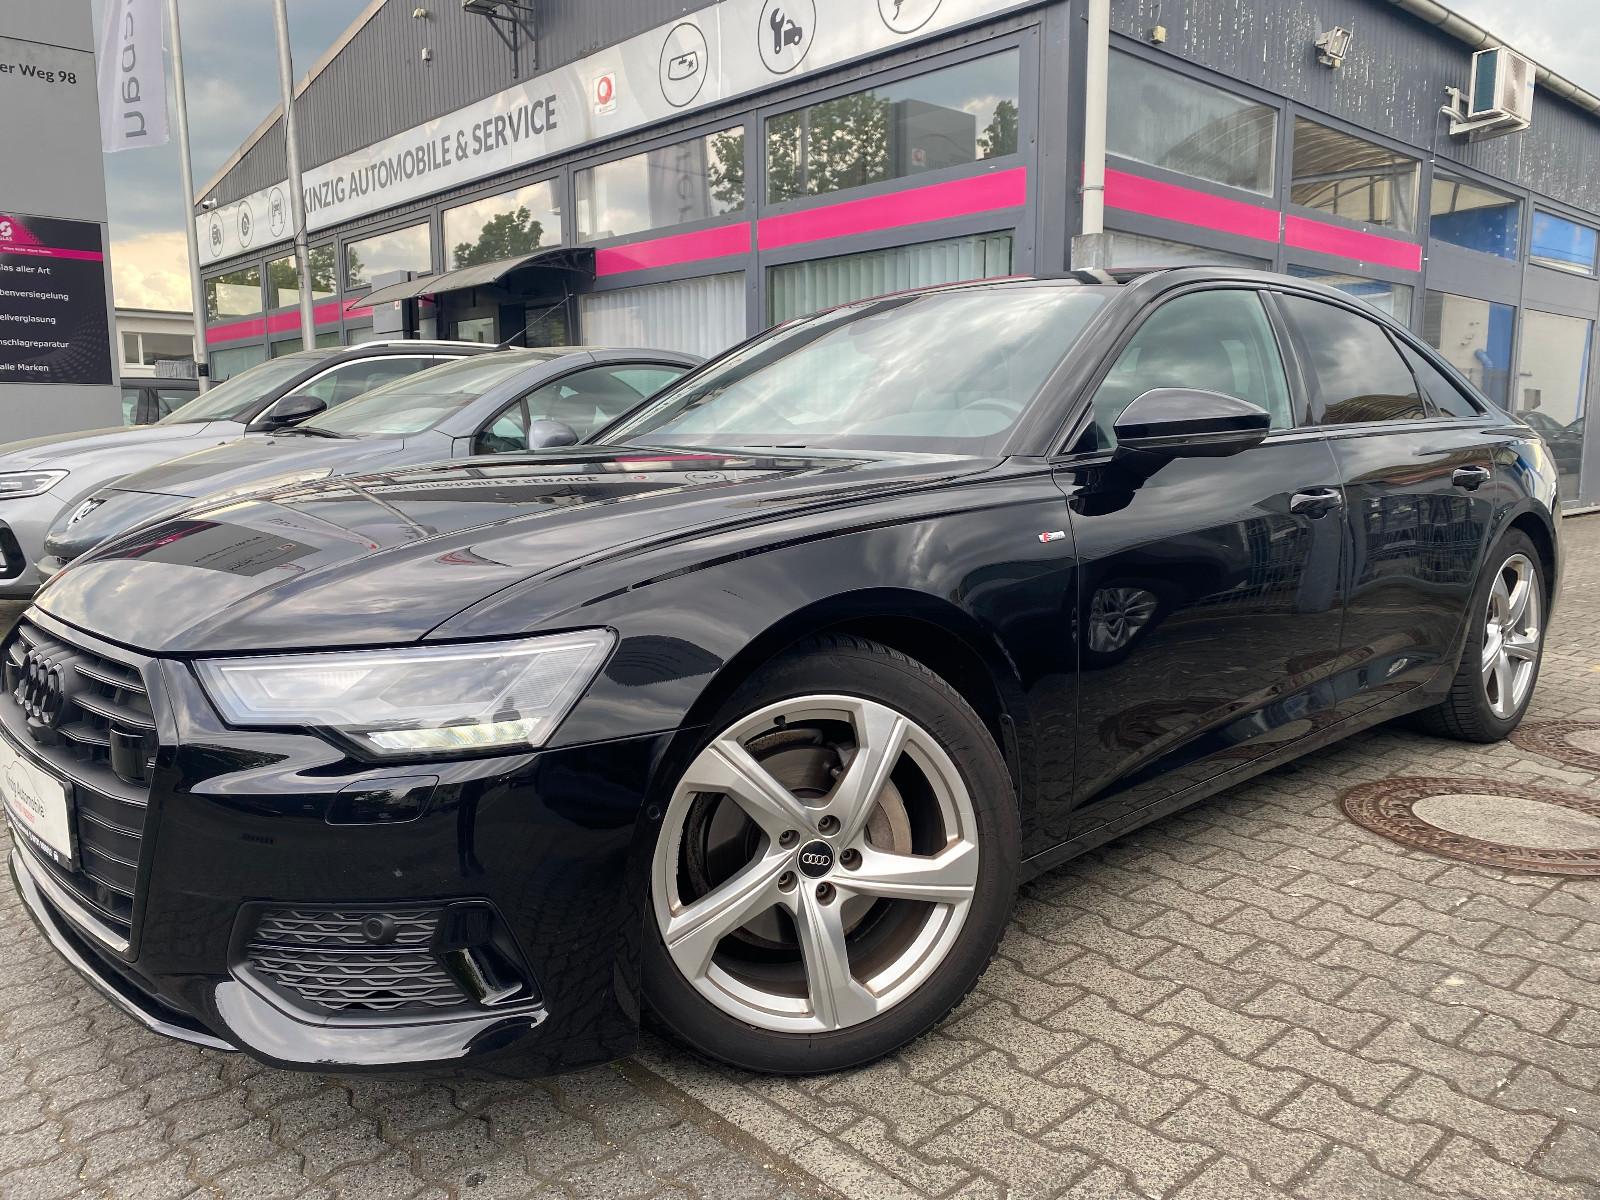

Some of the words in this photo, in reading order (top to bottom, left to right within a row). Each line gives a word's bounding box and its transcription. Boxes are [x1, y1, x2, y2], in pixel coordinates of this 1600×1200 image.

[19, 63, 55, 83] Weg
[58, 70, 77, 84] 98
[349, 135, 452, 199] AUTOMOBILE
[455, 129, 468, 162] &
[472, 94, 558, 155] SERVICE
[15, 265, 35, 273] aller
[37, 266, 51, 274] Art
[0, 362, 15, 371] alle
[17, 363, 49, 372] Marken
